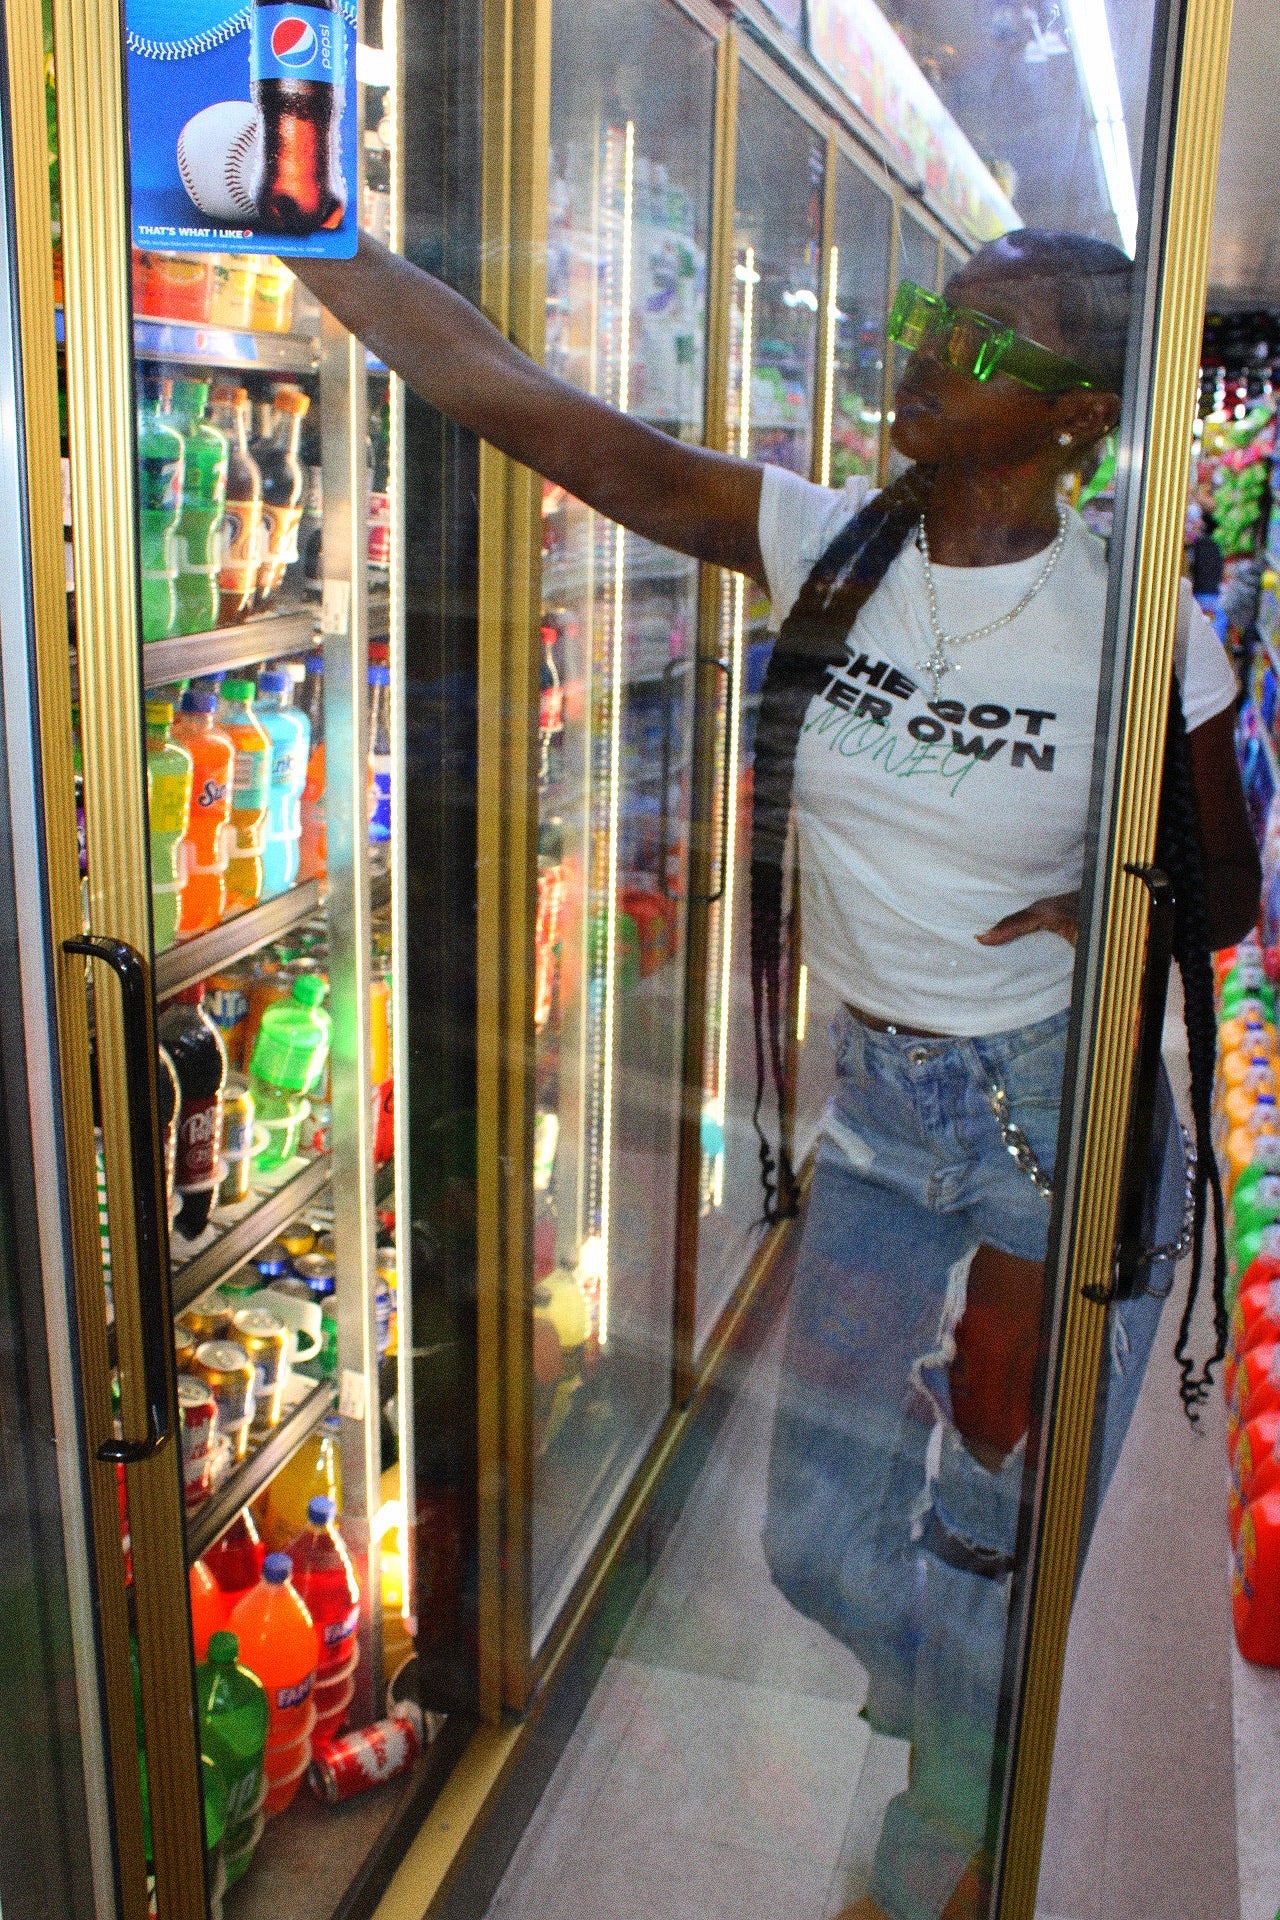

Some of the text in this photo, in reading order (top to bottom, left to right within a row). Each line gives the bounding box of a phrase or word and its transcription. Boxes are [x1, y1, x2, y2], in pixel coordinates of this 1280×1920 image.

[319, 24, 332, 69] pepsi
[138, 225, 243, 239] THAT'S WHAT I LIKE
[926, 699, 1057, 737] GOT
[907, 716, 1056, 773] OWN
